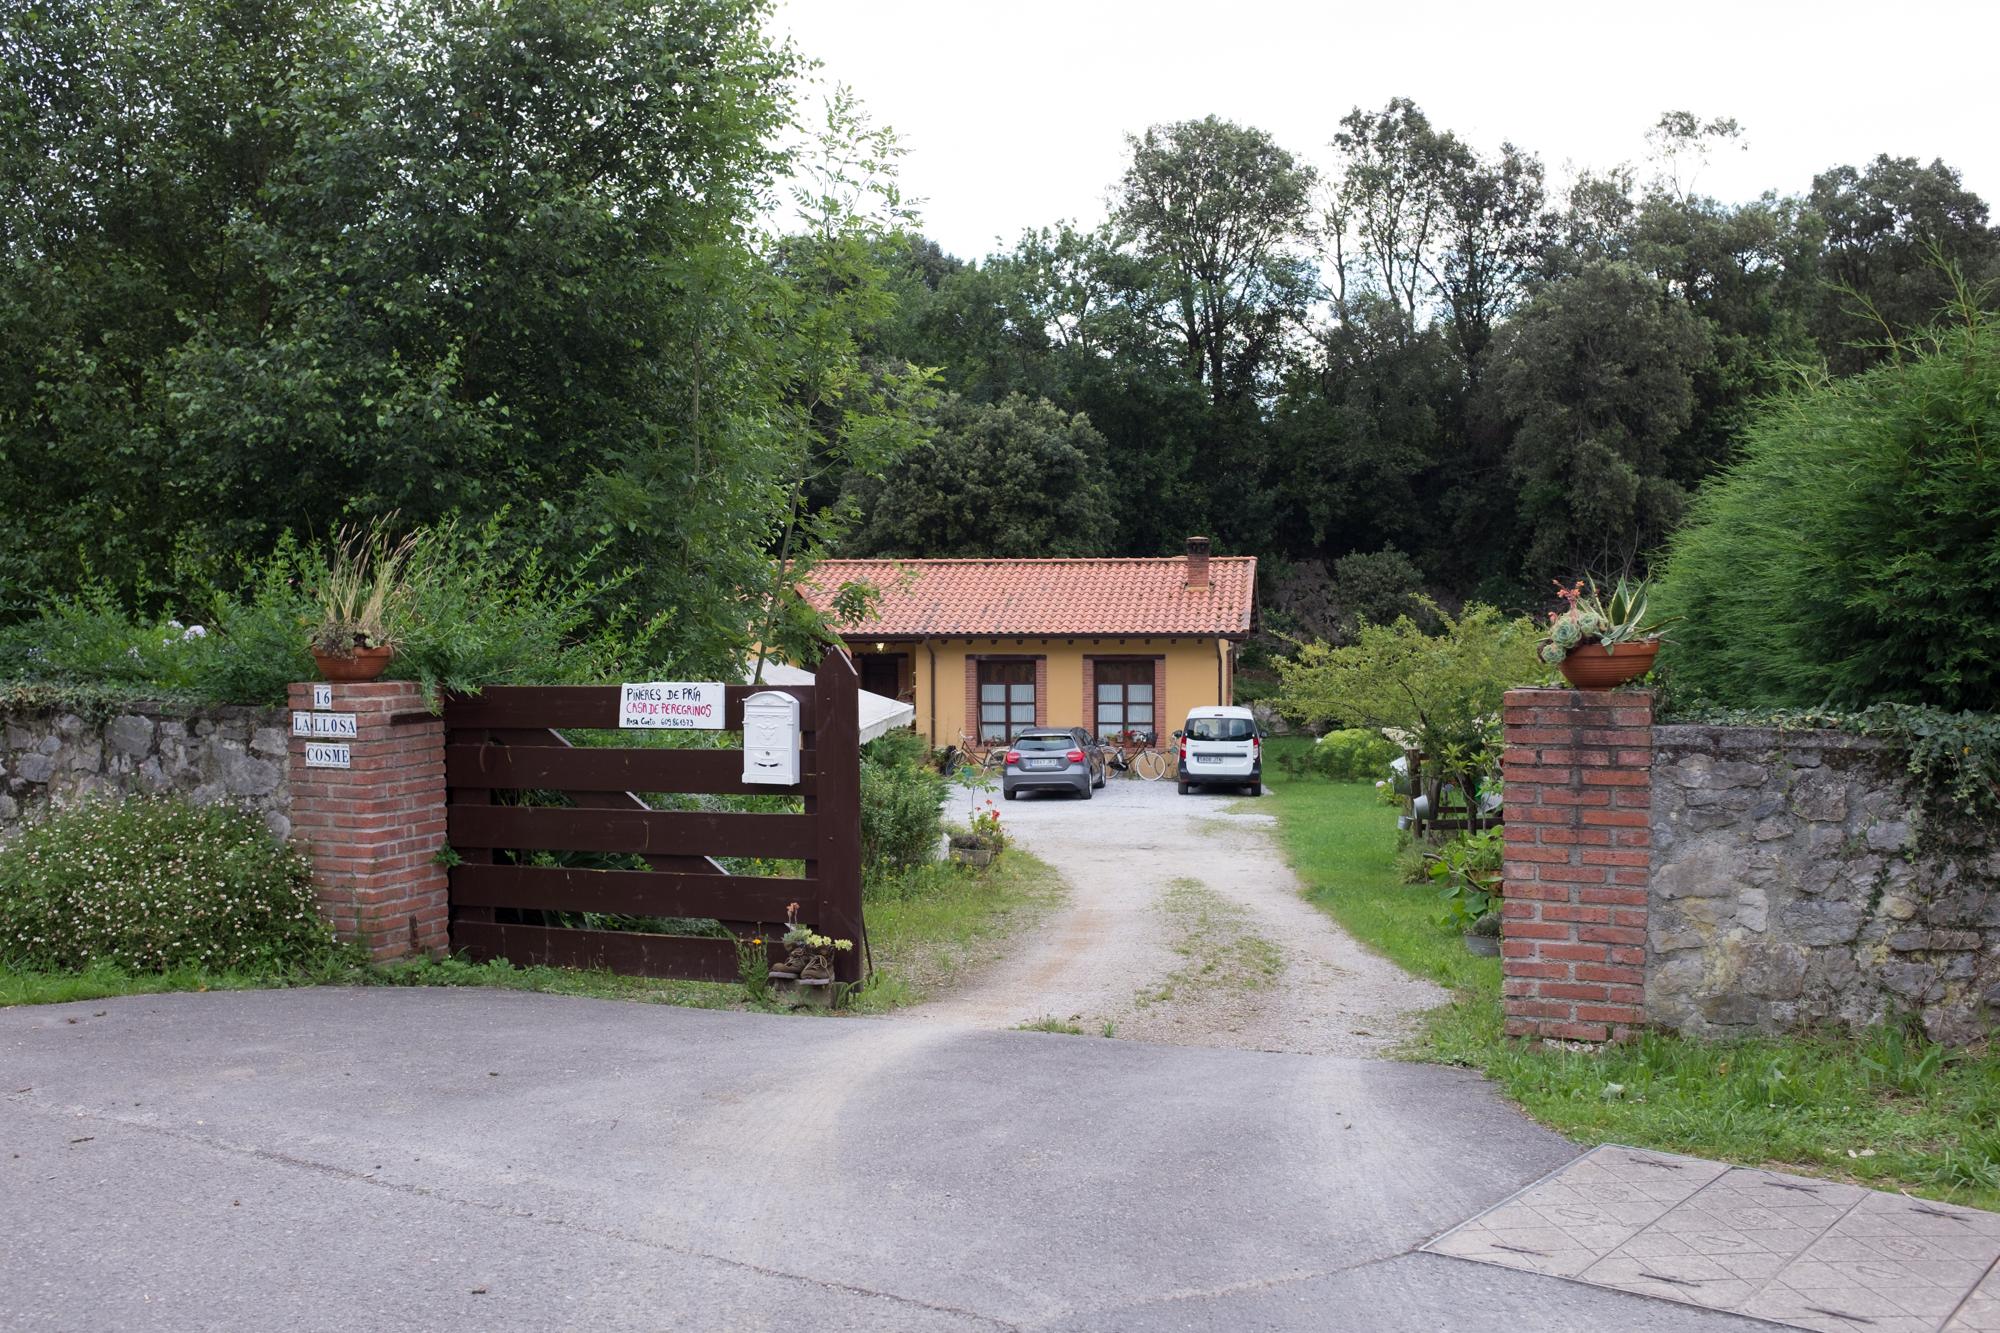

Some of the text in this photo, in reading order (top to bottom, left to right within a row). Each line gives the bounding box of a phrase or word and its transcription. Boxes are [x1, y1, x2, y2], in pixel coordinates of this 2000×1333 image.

[316, 691, 330, 704] 16
[667, 690, 679, 700] DE
[682, 687, 700, 701] PRÍA
[626, 702, 711, 717] CASA DE PEREGRINOS
[295, 718, 355, 733] LA LLOSA
[307, 748, 349, 763] COSME
